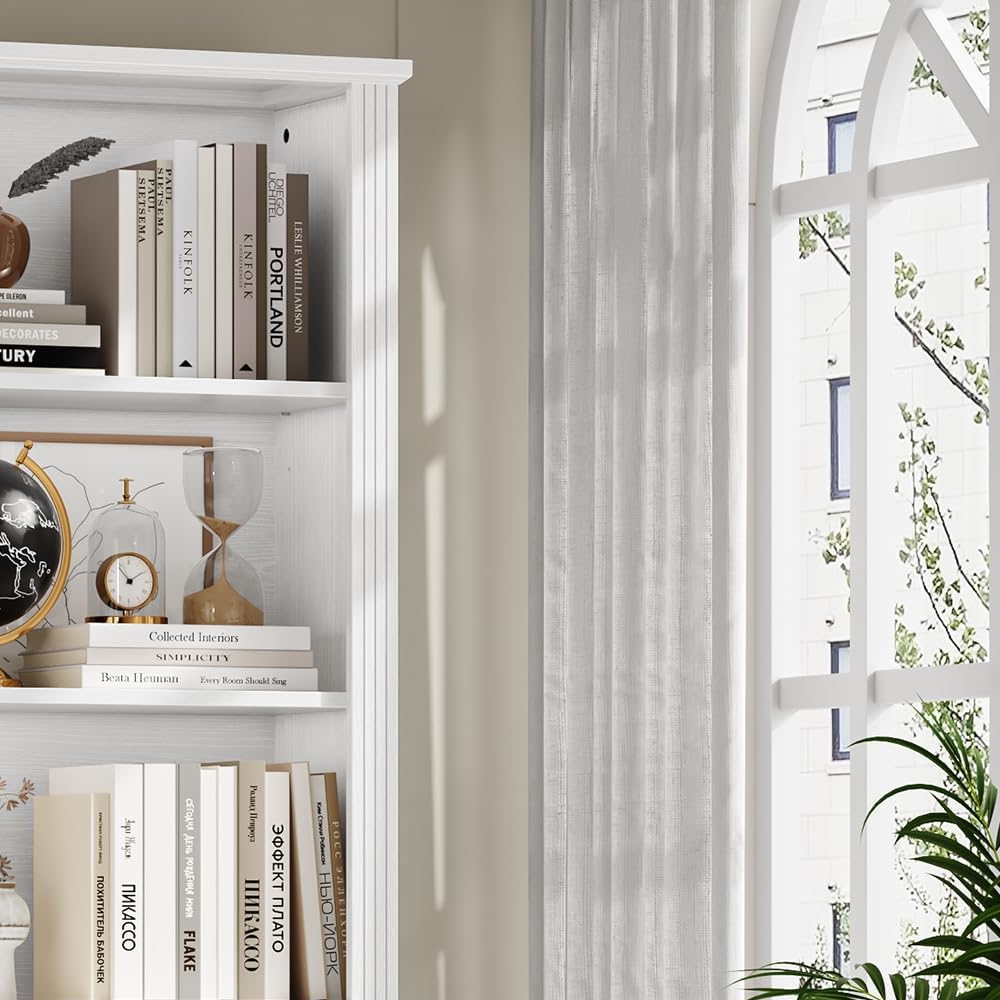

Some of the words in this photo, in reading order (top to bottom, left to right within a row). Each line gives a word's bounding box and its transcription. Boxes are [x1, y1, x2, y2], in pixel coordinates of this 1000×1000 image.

[138, 177, 146, 244] SIETSEMA
[156, 167, 164, 237] SIETSEMA
[268, 171, 277, 223] UCHITEL
[276, 178, 285, 217] DIEGO
[183, 230, 193, 295] KINFOLK
[294, 221, 303, 255] LESLIE
[243, 233, 253, 299] KINFOLK
[269, 247, 284, 348] PORTLAND
[149, 631, 195, 643] Collected
[199, 631, 239, 644] Interiors
[155, 653, 231, 663] SIMPLICITY
[101, 672, 130, 683] Beata
[222, 676, 244, 686] Room
[245, 676, 270, 686] Should
[183, 833, 195, 855] ДЕНЬ
[271, 824, 285, 891] ЭФФЕКТ
[332, 821, 342, 859] РОСС
[96, 876, 105, 938] ПОХИТИТЕЛЬ
[121, 884, 136, 952] ПИКАССО
[185, 897, 194, 918] МИРА
[244, 878, 261, 972] ПИКАССО
[271, 897, 285, 953] ПЛАТО
[319, 872, 339, 976] НЬЮ-ЙОРК
[96, 940, 105, 984] БАБОЧЕК
[183, 930, 196, 972] FLAKE
